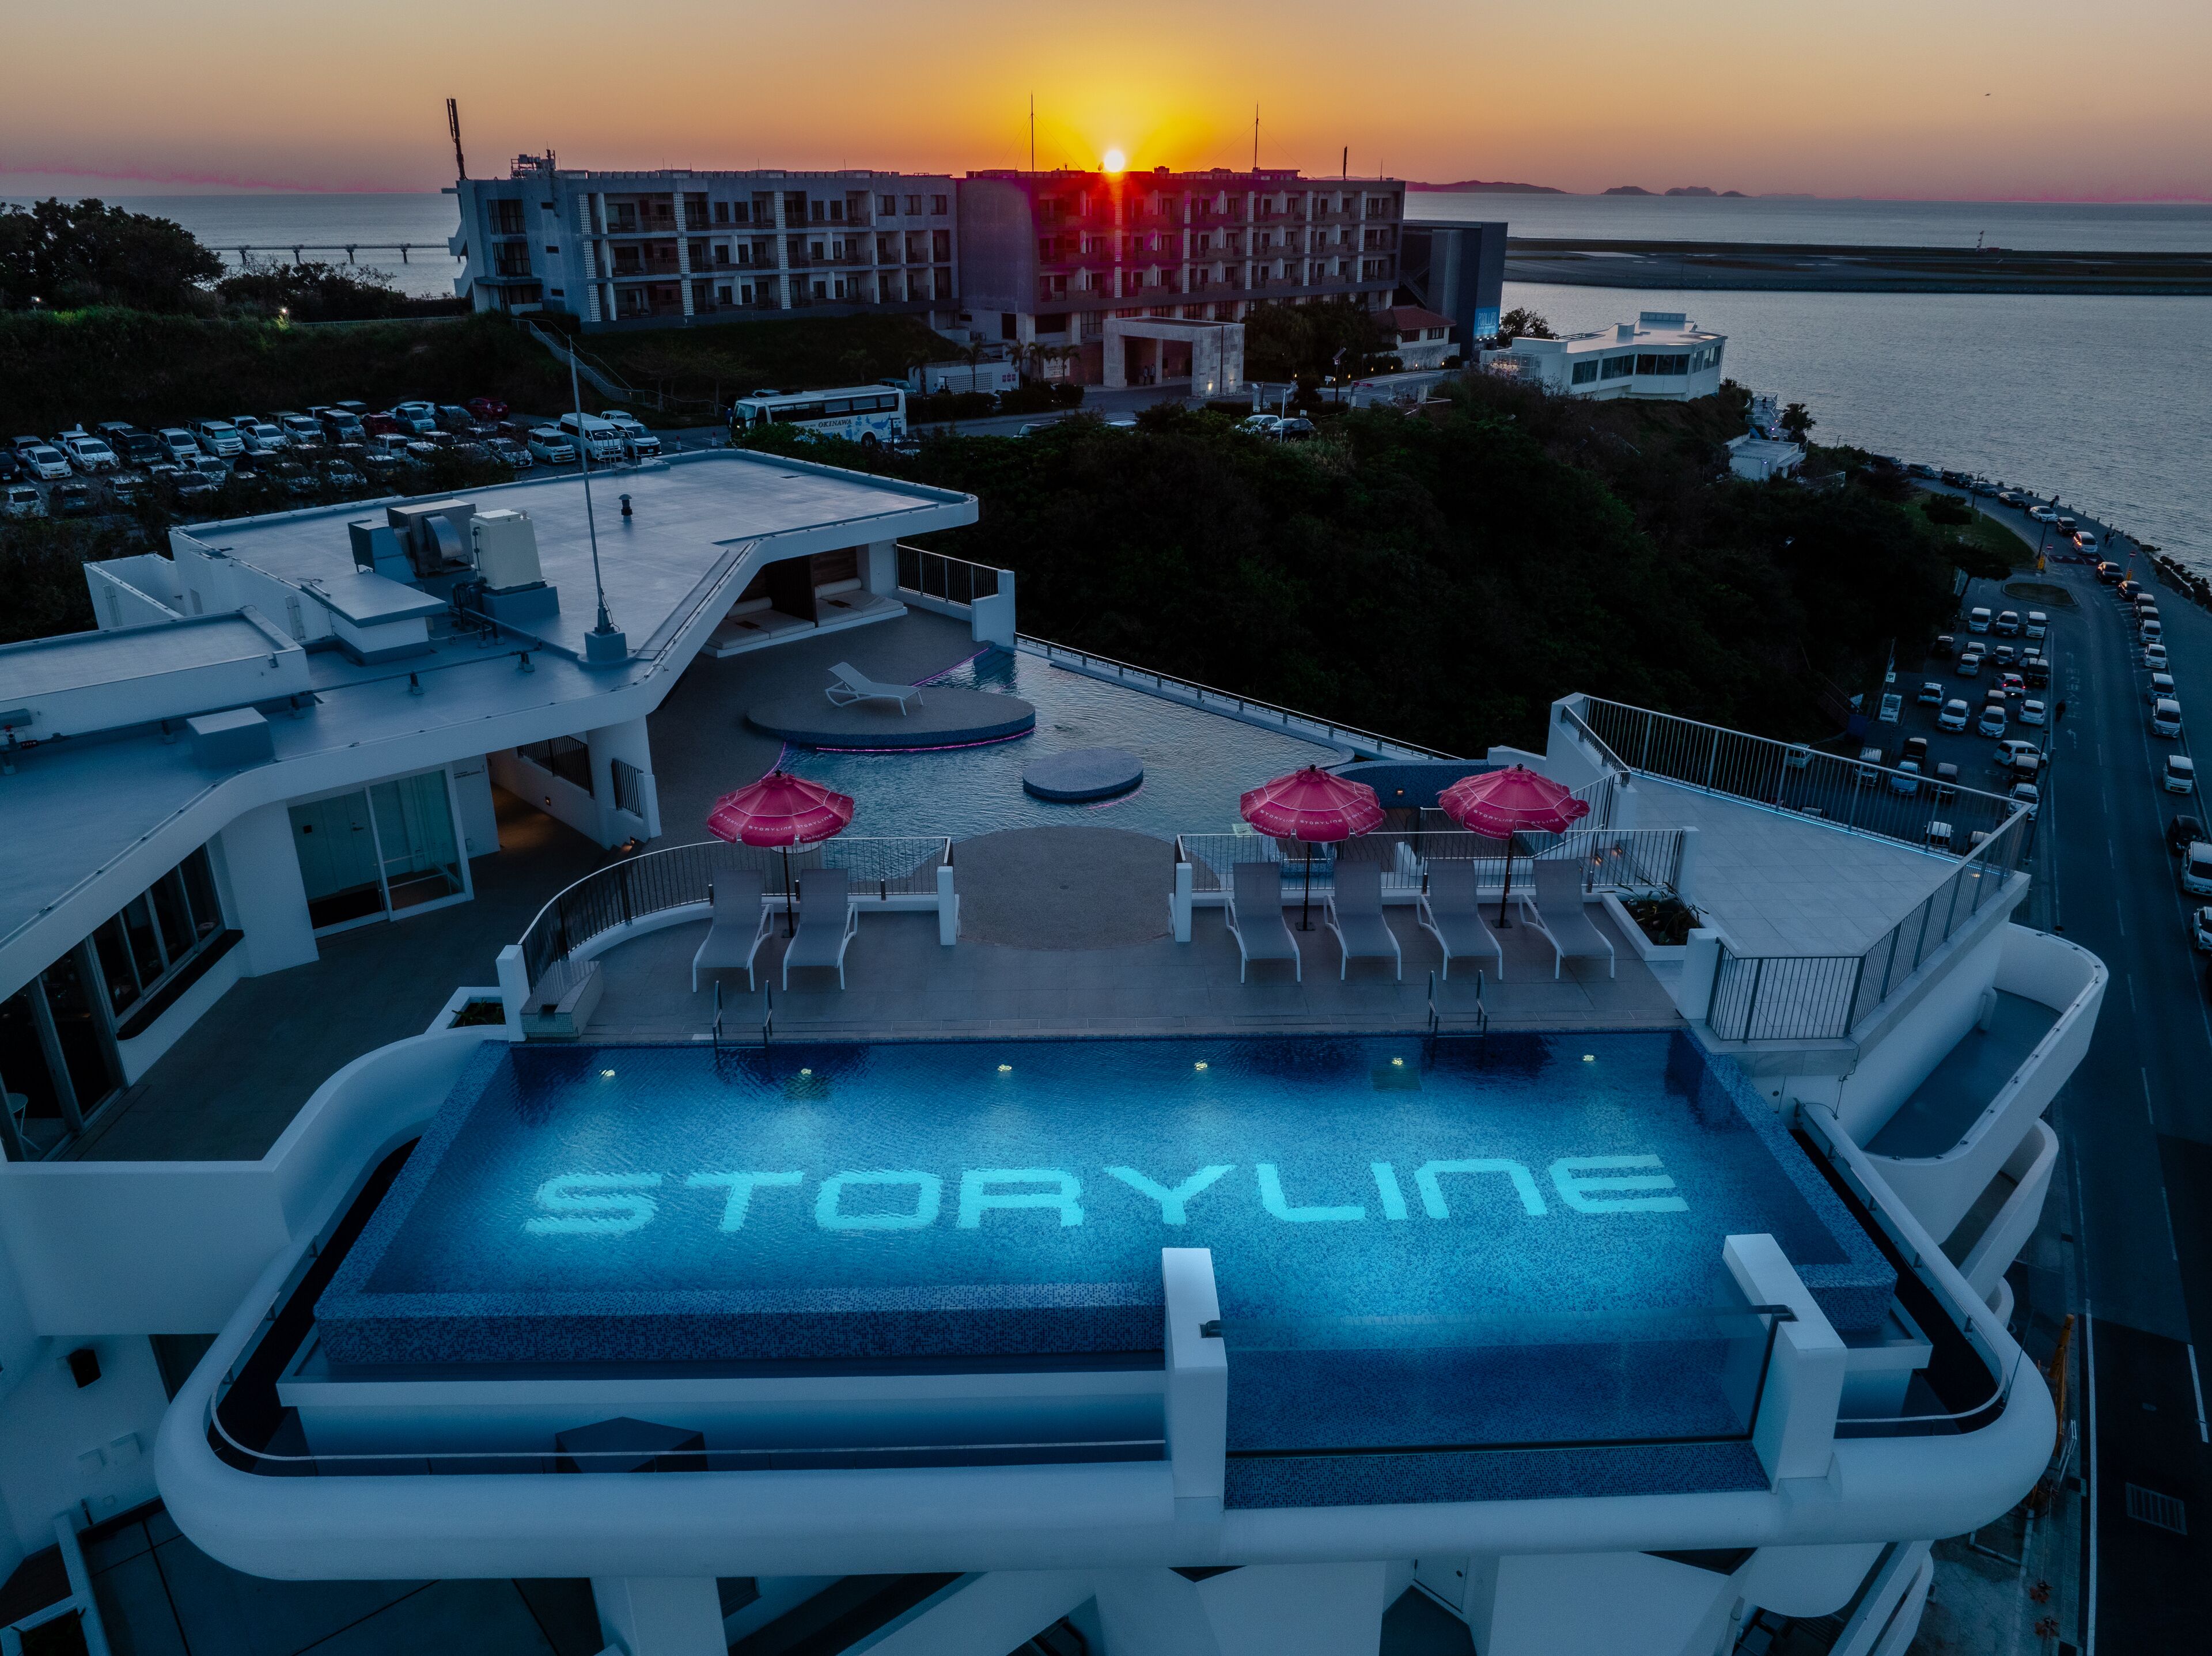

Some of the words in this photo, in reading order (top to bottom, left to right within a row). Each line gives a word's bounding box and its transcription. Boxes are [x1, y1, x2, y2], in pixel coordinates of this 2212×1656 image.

[819, 419, 852, 427] OKINAWA
[797, 814, 834, 828] STORYLINE
[1260, 809, 1295, 823] STORYLINE
[1474, 809, 1513, 823] STORYLINE
[525, 1154, 1690, 1234] STORYLINE
